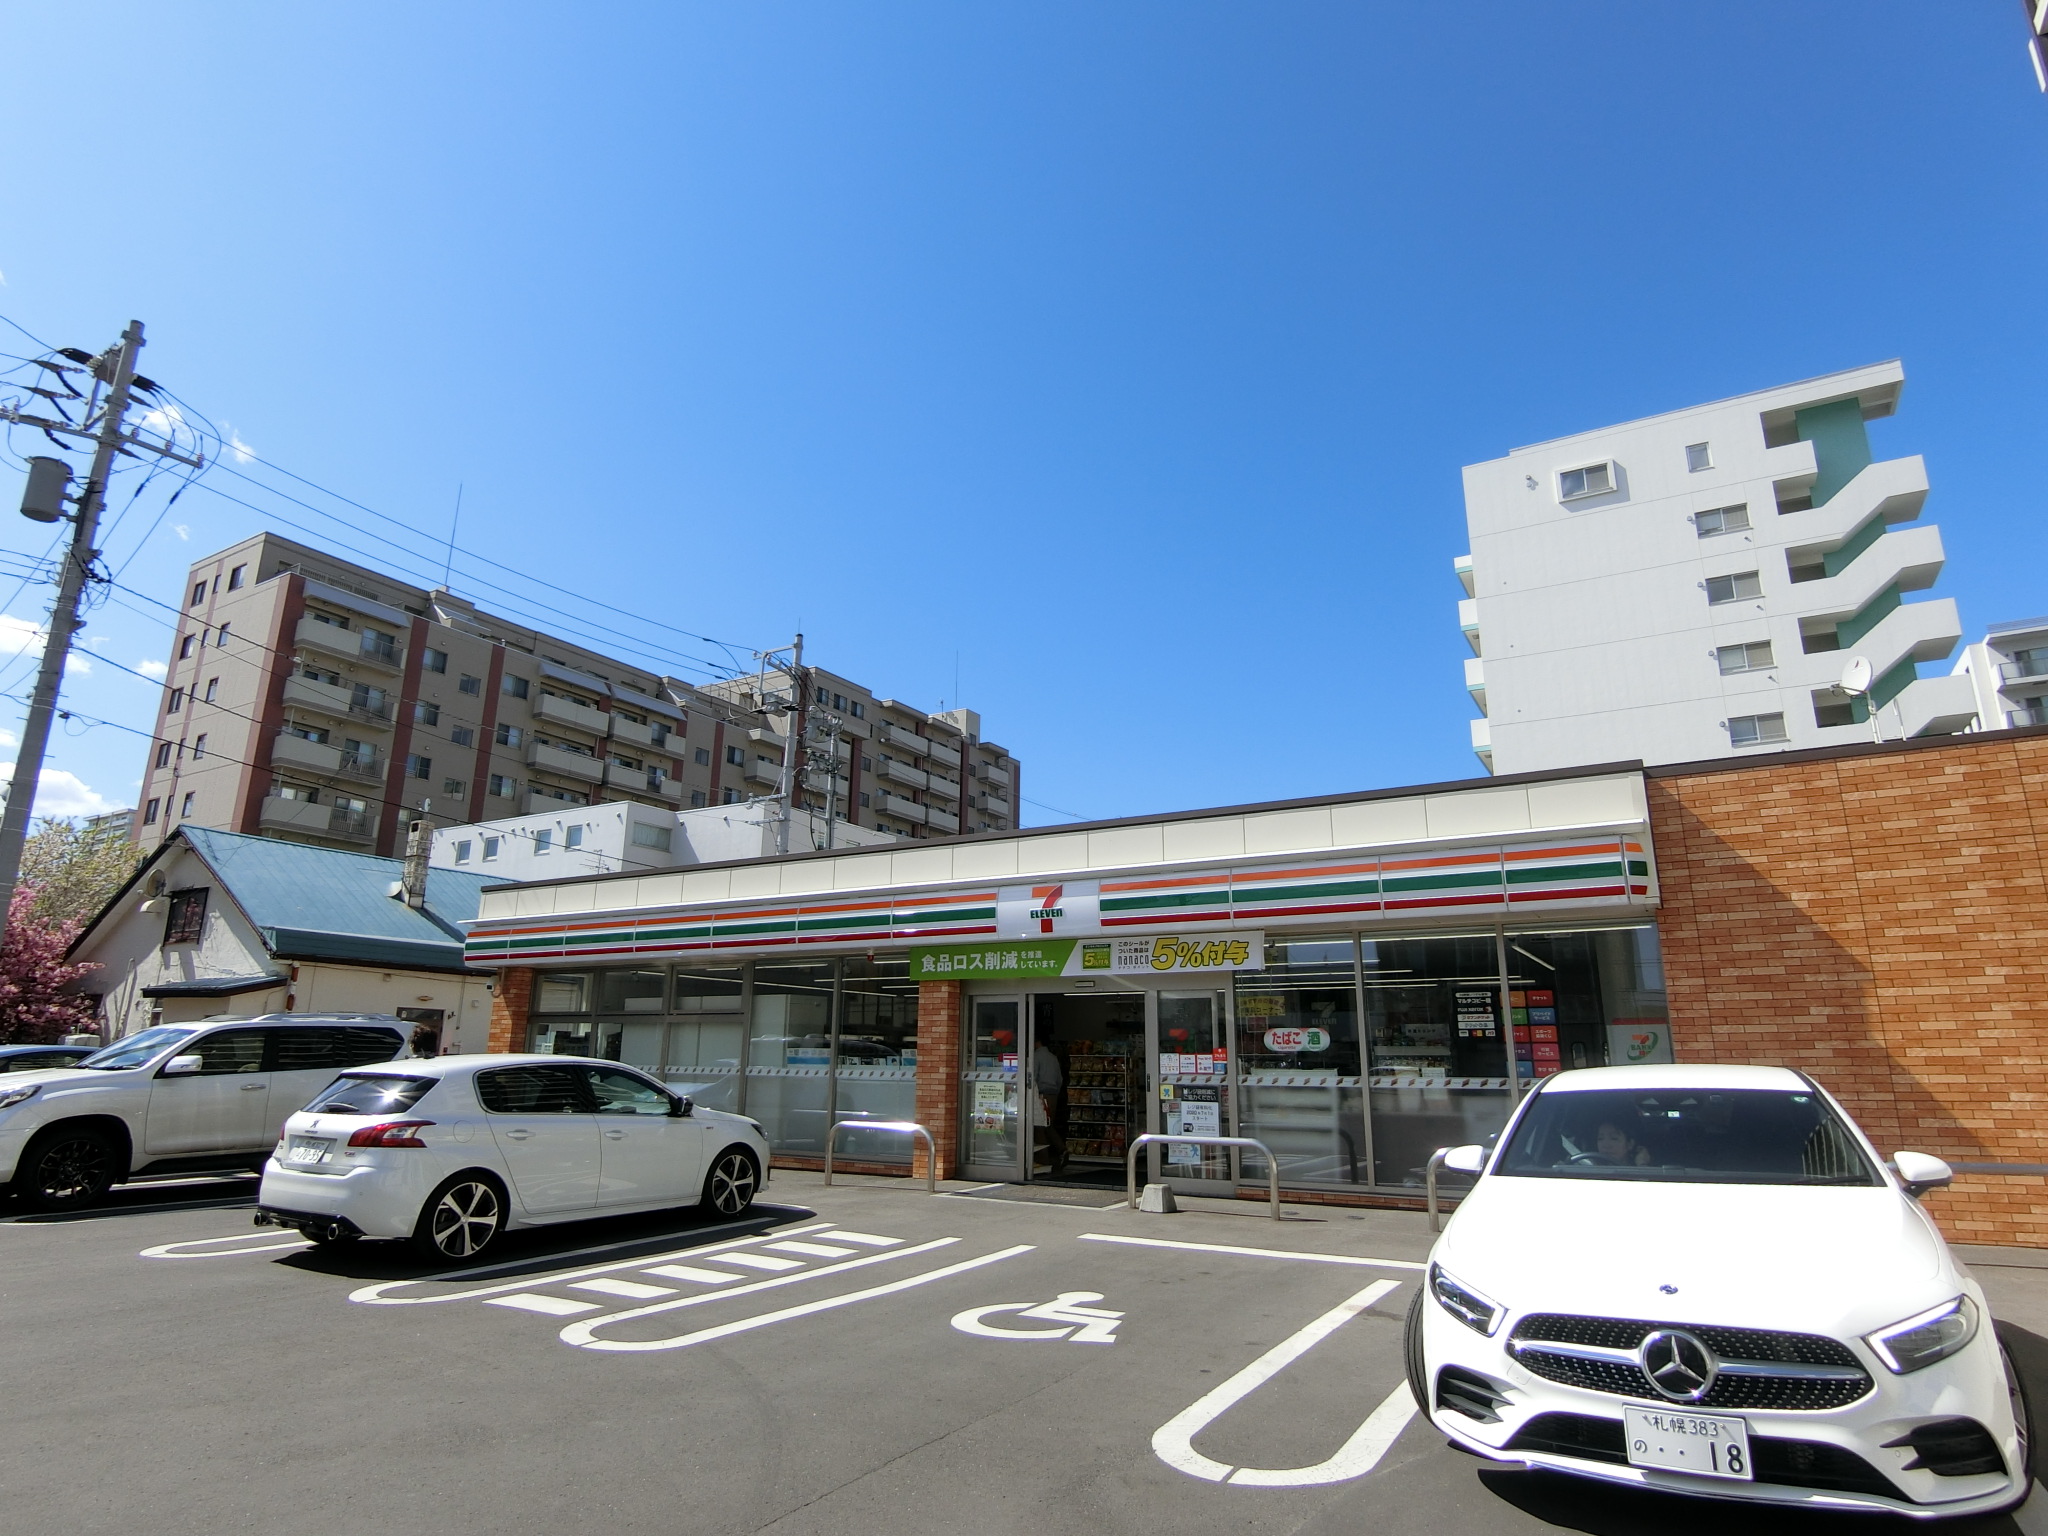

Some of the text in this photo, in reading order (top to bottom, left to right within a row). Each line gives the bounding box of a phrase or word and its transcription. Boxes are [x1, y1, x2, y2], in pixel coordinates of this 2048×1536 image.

[921, 951, 1018, 973] 食品ロス削減
[1117, 954, 1150, 966] nanaco
[1151, 936, 1250, 971] 5%付与
[1020, 960, 1058, 969] しています。
[1272, 1030, 1321, 1046] たばこ 酒
[1633, 1438, 1648, 1454] の
[1708, 1440, 1744, 1474] 18
